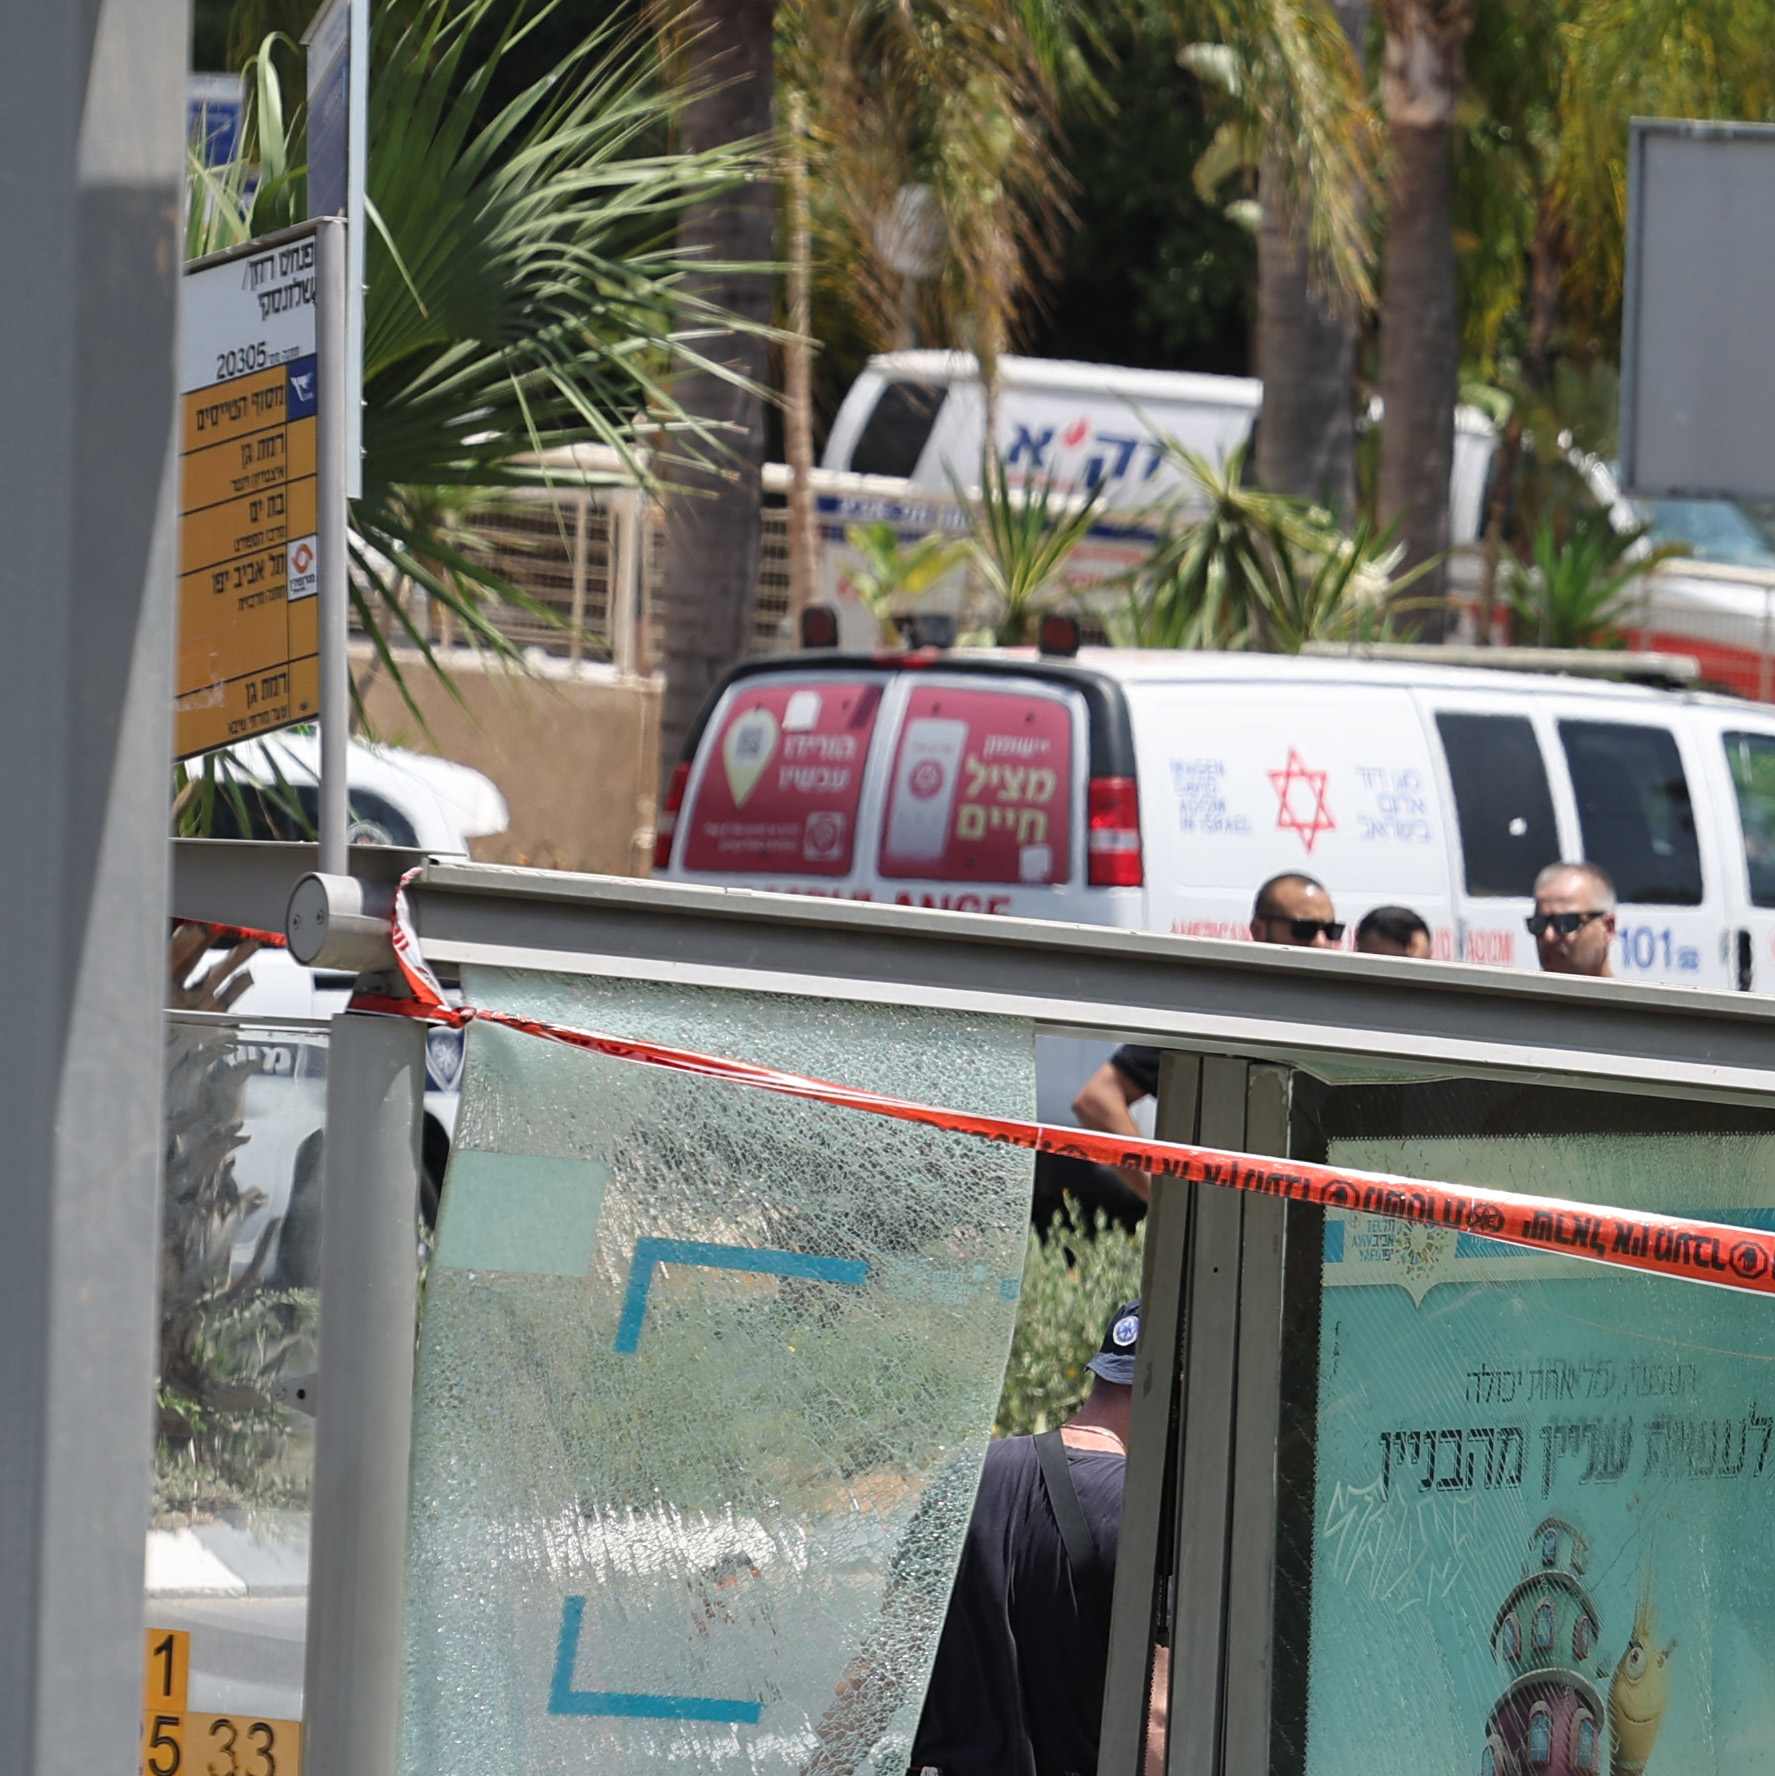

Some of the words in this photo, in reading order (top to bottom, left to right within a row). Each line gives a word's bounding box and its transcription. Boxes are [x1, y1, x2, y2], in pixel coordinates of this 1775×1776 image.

[216, 341, 267, 380] 20305
[212, 572, 229, 594] יפו
[233, 560, 265, 588] אביב
[965, 754, 1058, 803] מציל
[957, 803, 1048, 846] חיים
[1620, 926, 1672, 968] 101
[1522, 1210, 1606, 1257] ישראל
[1613, 1222, 1650, 1258] אין
[1655, 1228, 1726, 1271] מעבר
[1466, 1363, 1524, 1404] יכולה
[1526, 1366, 1576, 1402] אחת
[1379, 1427, 1525, 1503] מהבניין
